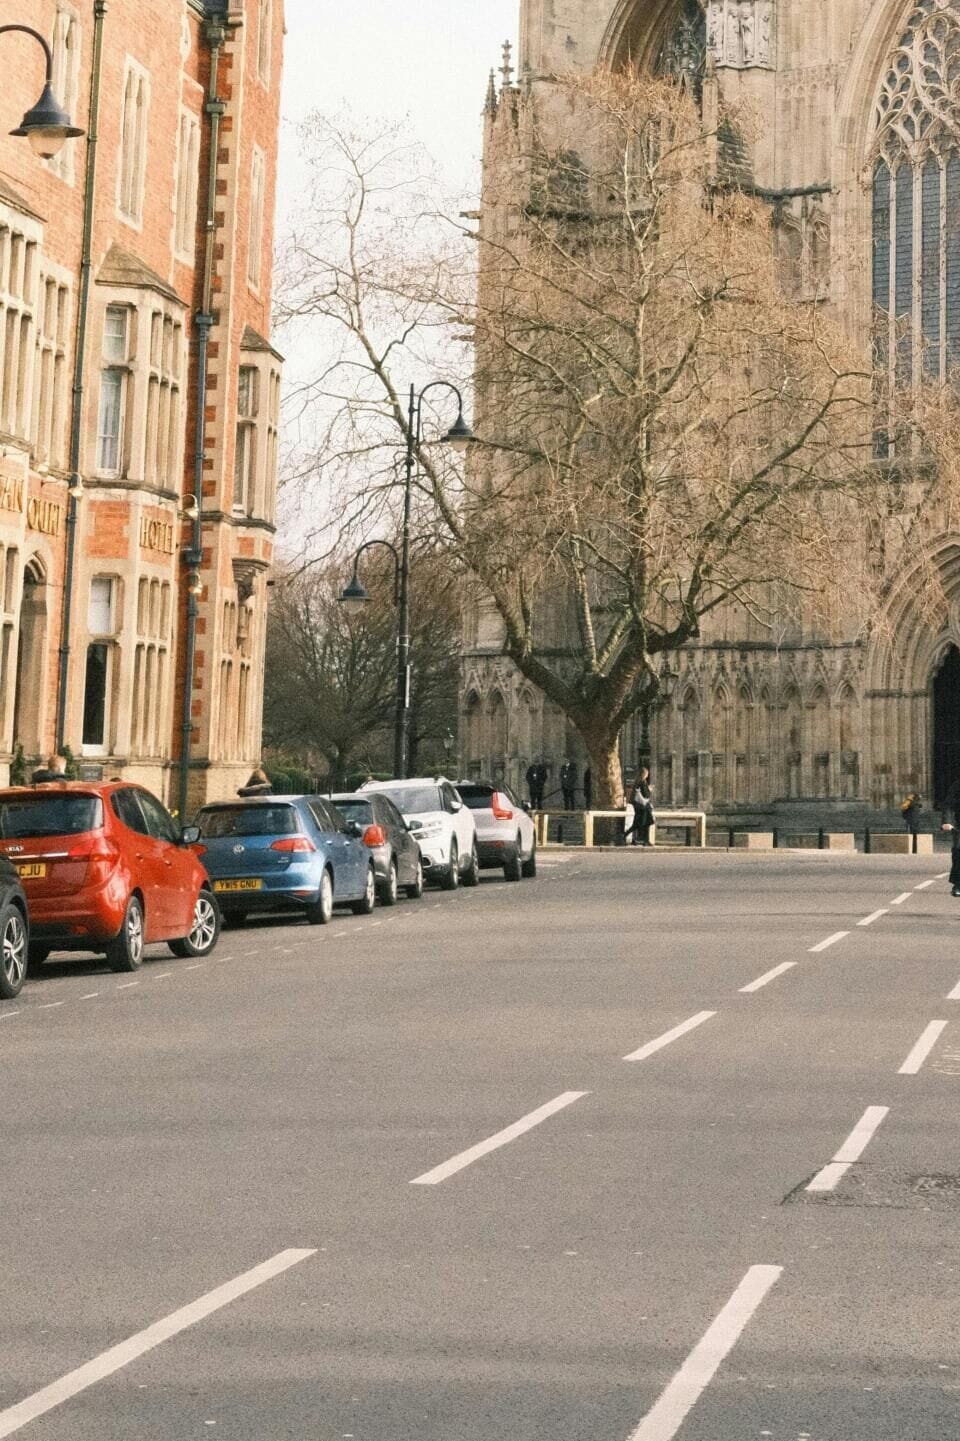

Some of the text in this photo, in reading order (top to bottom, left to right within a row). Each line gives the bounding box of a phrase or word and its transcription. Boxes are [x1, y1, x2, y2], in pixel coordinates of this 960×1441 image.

[0, 477, 174, 555] AN OURT HOTEL
[19, 864, 41, 876] CJU
